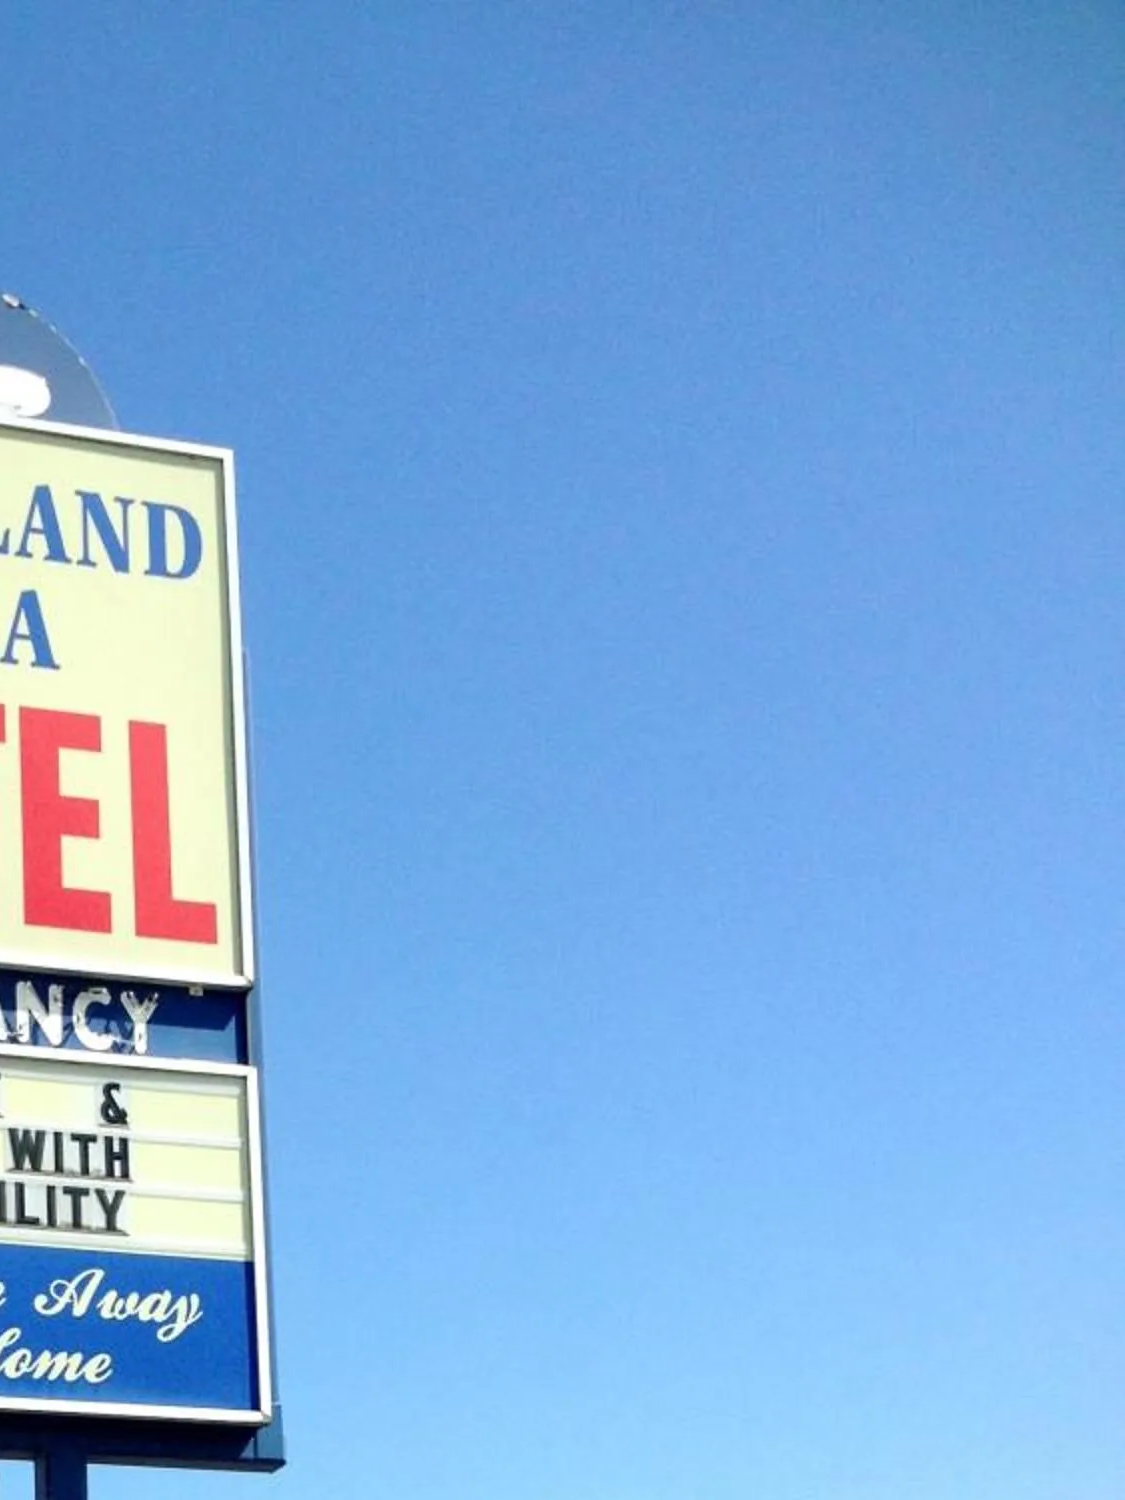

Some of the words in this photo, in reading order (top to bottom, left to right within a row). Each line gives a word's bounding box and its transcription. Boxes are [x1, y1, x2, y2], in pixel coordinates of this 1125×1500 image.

[100, 1081, 129, 1125] &
[7, 1127, 131, 1180] WITH
[34, 1268, 203, 1343] Away
